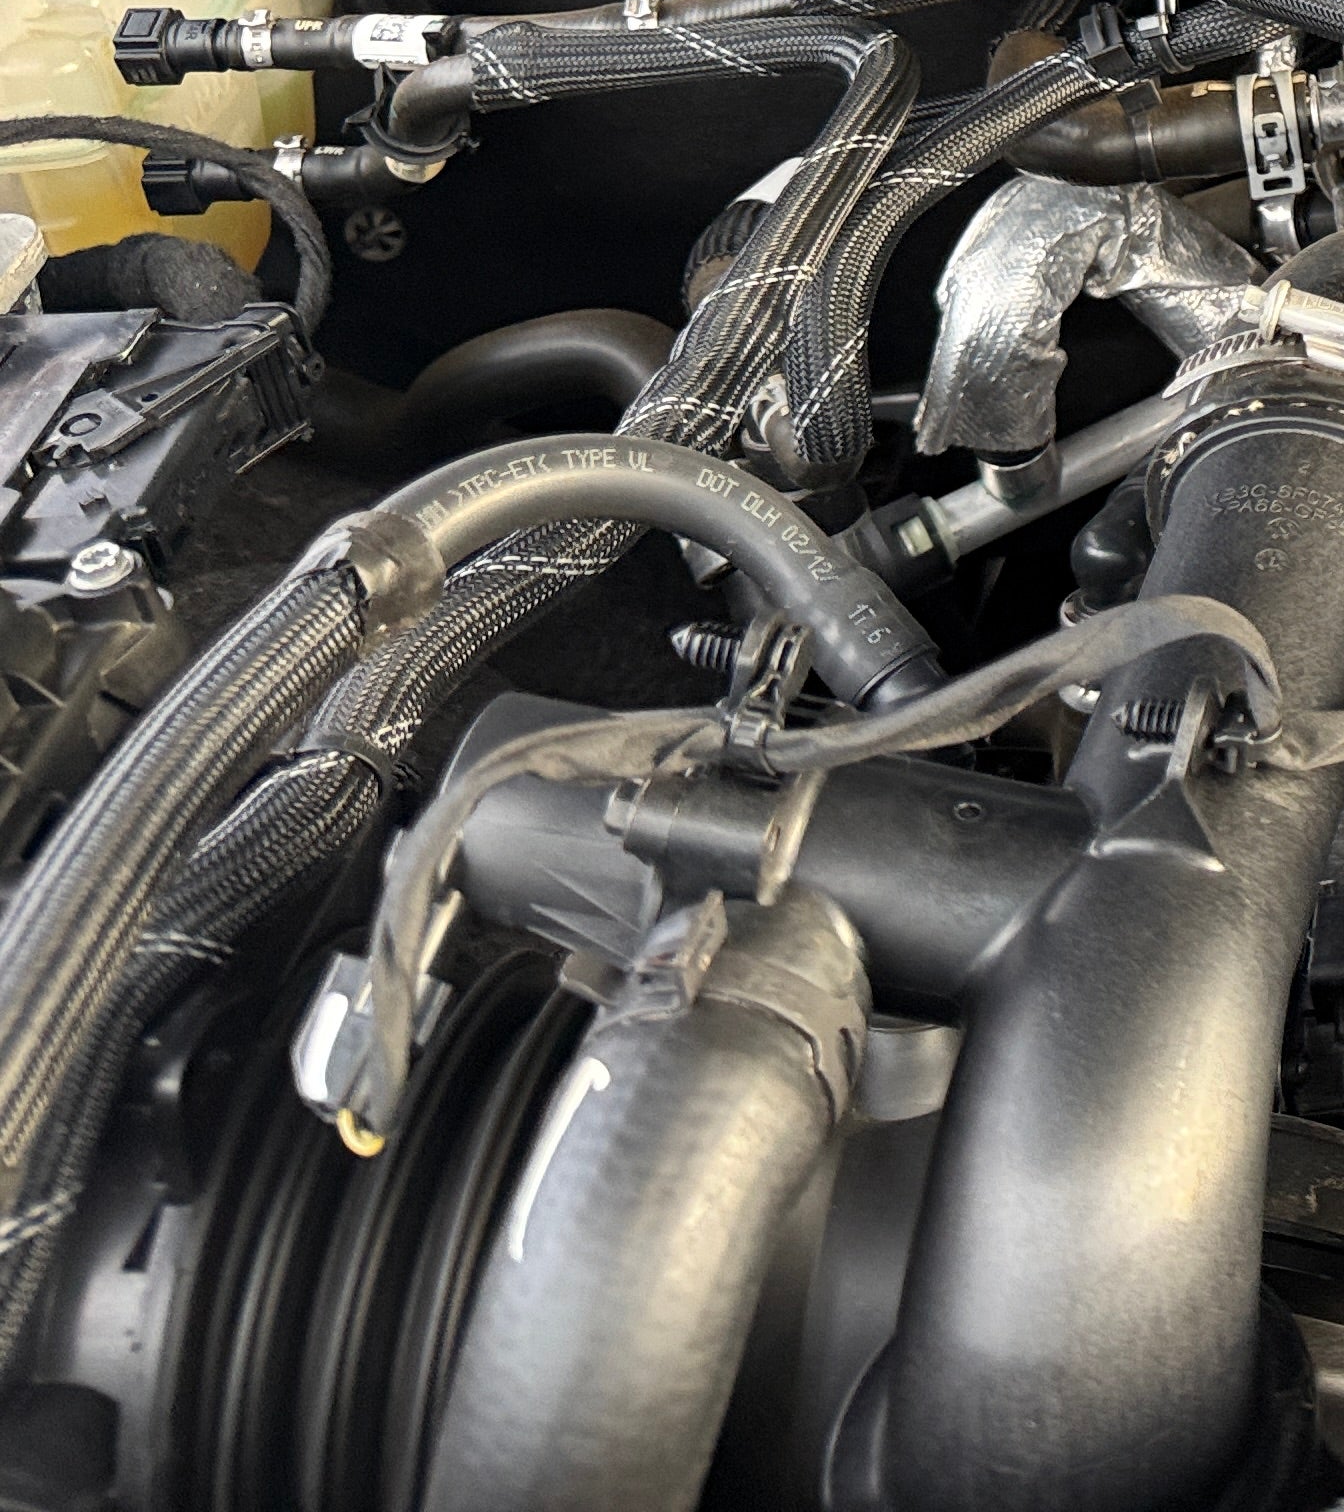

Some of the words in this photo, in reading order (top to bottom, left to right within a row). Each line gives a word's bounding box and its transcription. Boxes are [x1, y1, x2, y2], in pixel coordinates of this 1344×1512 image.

[562, 447, 617, 471] TYPE
[627, 450, 657, 473] VL
[695, 466, 741, 500] DOT
